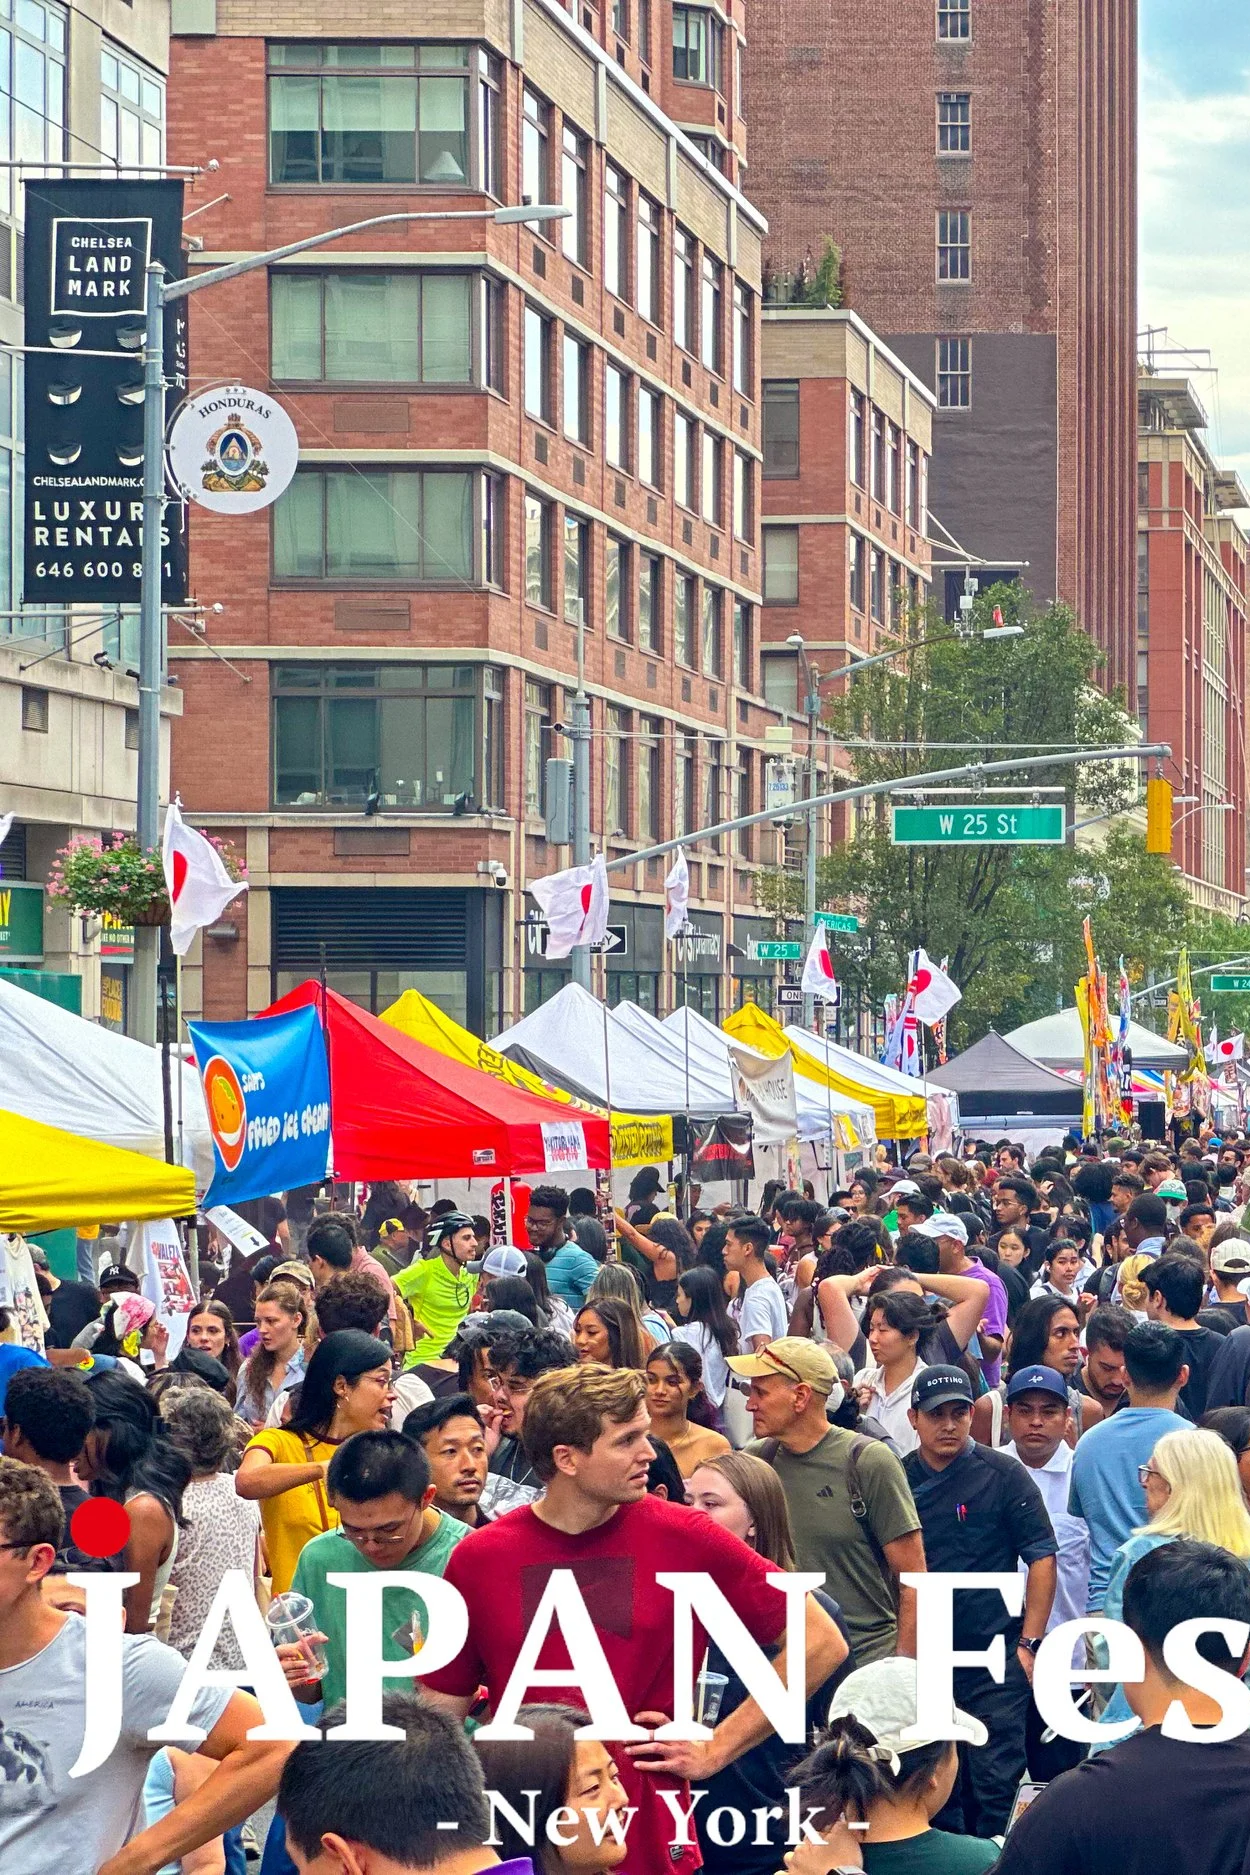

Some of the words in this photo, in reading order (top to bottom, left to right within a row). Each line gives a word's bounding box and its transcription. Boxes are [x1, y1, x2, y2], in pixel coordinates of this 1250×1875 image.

[71, 237, 133, 249] CHELSEA
[68, 255, 132, 273] LAND
[68, 279, 130, 297] MARK
[198, 398, 272, 420] HONDURAS
[36, 562, 74, 577] 646
[83, 562, 123, 577] 600
[939, 814, 954, 835] W
[963, 813, 989, 835] 25
[997, 813, 1018, 835] St
[760, 944, 769, 957] W
[774, 944, 788, 957] 25
[1233, 979, 1240, 988] W
[1241, 979, 1250, 988] 24
[786, 991, 804, 1000] ONE
[927, 1376, 963, 1387] BOTTINO
